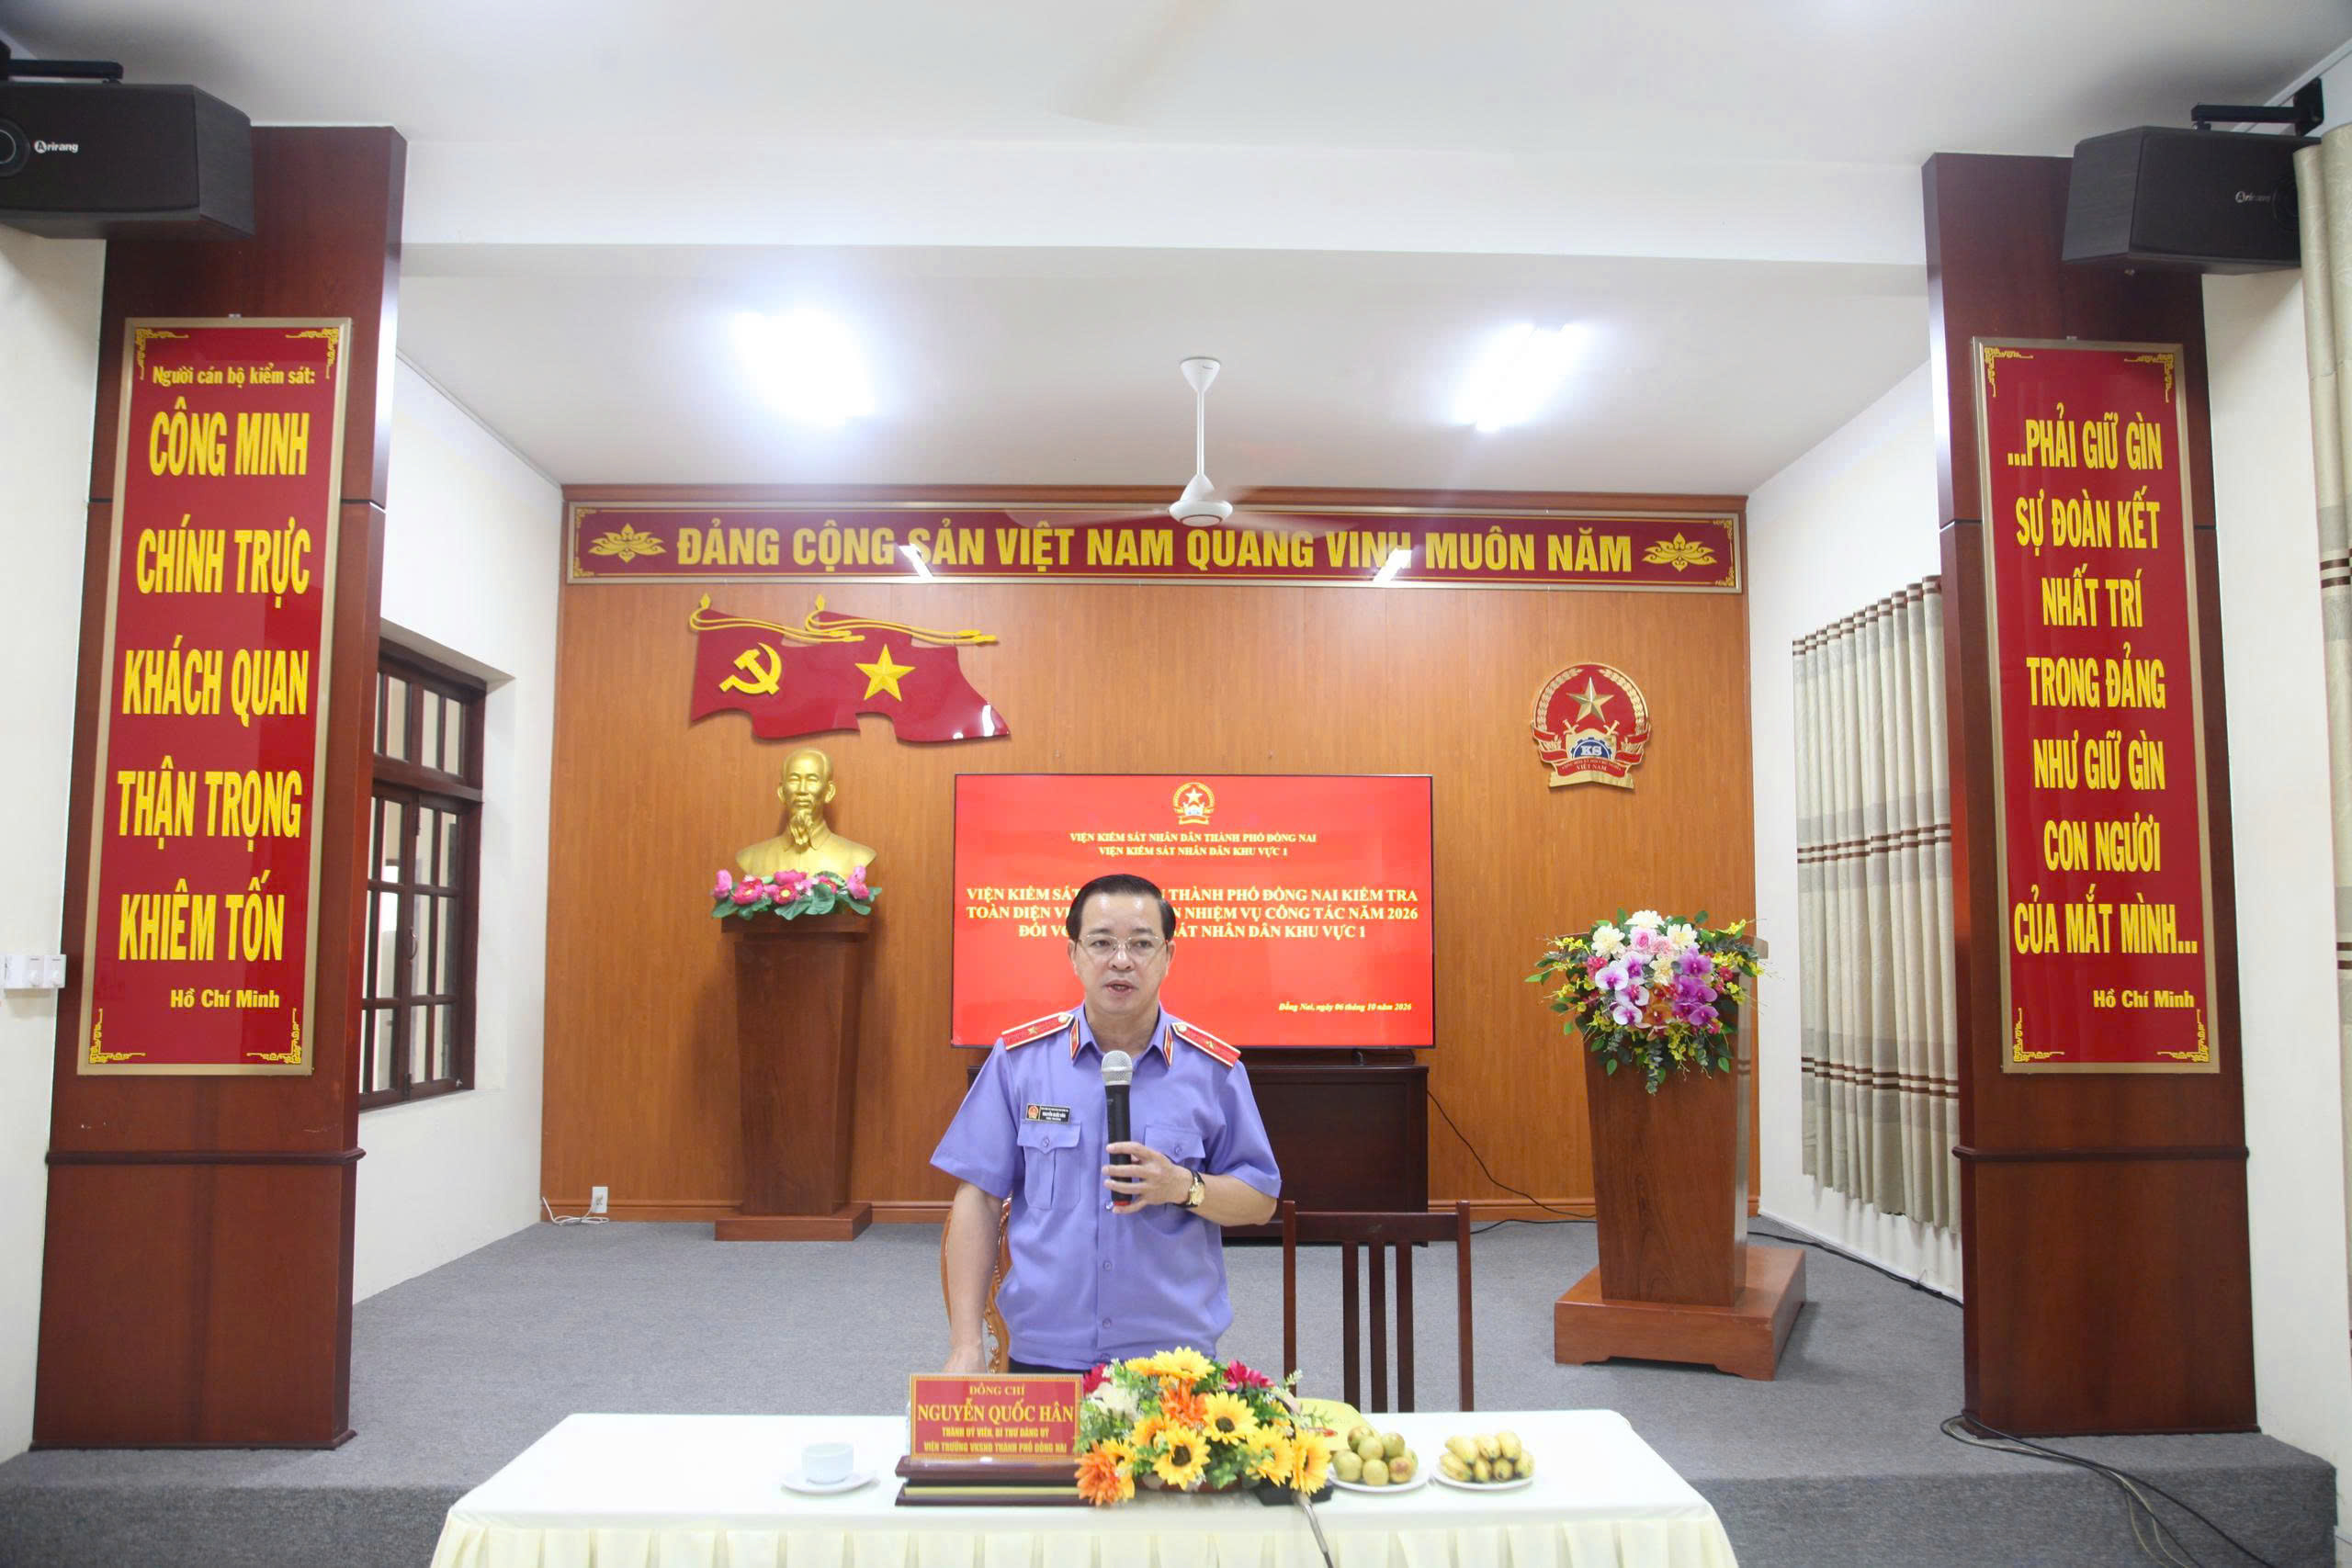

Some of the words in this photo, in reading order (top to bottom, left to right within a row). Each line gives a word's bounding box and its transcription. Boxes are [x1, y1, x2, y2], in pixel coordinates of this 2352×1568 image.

[34, 141, 79, 153] Arirang
[153, 367, 194, 386] Người
[198, 367, 222, 384] cán
[227, 367, 245, 389] bộ
[249, 363, 285, 384] kiểm
[288, 367, 315, 384] sát:
[150, 397, 228, 477] CÔNG
[235, 412, 310, 476] MINH
[2007, 402, 2077, 468] ...PHẢI
[2083, 412, 2119, 469] GIỮ
[2126, 412, 2163, 470] GÌN
[2016, 489, 2044, 557] SỰ
[2052, 489, 2112, 548] ĐOÀN
[2118, 485, 2161, 549] KẾT
[677, 518, 779, 566] ĐẢNG
[794, 520, 895, 571] CỘNG
[908, 517, 985, 566] SẢN
[996, 521, 1074, 572] VIỆT
[1088, 528, 1172, 567] NAM
[1187, 528, 1314, 571] QUANG
[1326, 531, 1412, 569] VINH
[1426, 525, 1535, 571] MUÔN
[1548, 528, 1632, 572] NĂM
[137, 514, 225, 594] CHÍNH
[234, 516, 311, 609] TRỰC
[2041, 563, 2099, 626] NHẤT
[2106, 569, 2143, 627] TRÍ
[122, 635, 223, 716] KHÁCH
[232, 649, 310, 728] QUAN
[2027, 657, 2100, 708] TRONG
[2106, 642, 2166, 709] ĐẢNG
[1580, 745, 1602, 756] KS
[2034, 730, 2079, 790] NHƯ
[2085, 729, 2122, 790] GIỮ
[2128, 729, 2166, 791] GÌN
[118, 755, 198, 851] THẬN
[205, 769, 302, 852] TRỌNG
[1070, 832, 1094, 843] VIỆN
[1097, 831, 1125, 842] KIỂM
[1127, 831, 1147, 842] SÁT
[1149, 831, 1178, 842] NHÂN
[1181, 831, 1202, 842] DÂN
[1204, 832, 1240, 842] THÀNH
[1243, 831, 1265, 842] PHỐ
[1267, 831, 1296, 842] ĐỒNG
[1299, 833, 1317, 842] NAI
[2043, 820, 2089, 872] CON
[2095, 812, 2161, 873] NGƯƠI
[1099, 845, 1124, 857] VIỆN
[1126, 845, 1154, 855] KIỂM
[1156, 845, 1176, 855] SÁT
[1178, 845, 1206, 855] NHÂN
[1209, 845, 1230, 855] DÂN
[1233, 846, 1256, 856] KHU
[1258, 846, 1281, 858] VỰC
[1283, 847, 1287, 856] 1
[967, 886, 1004, 903] VIỆN
[1008, 886, 1050, 901] KIỂM
[1169, 886, 1224, 901] THÀNH
[1227, 886, 1260, 901] PHỐ
[1262, 886, 1307, 901] ĐỒNG
[1311, 888, 1339, 901] NAI
[1342, 886, 1384, 901] KIỂM
[1386, 888, 1418, 901] TRA
[119, 878, 216, 961] KHIÊM
[225, 870, 285, 962] TỐN
[967, 904, 1010, 919] TOÀN
[1013, 905, 1051, 921] DIỆN
[1185, 905, 1237, 922] NHIỆM
[1240, 907, 1261, 922] VỤ
[1265, 904, 1310, 919] CÔNG
[1313, 904, 1346, 919] TÁC
[1349, 905, 1384, 919] NĂM
[1387, 908, 1419, 919] 2026
[2014, 885, 2060, 954] CỦA
[2065, 884, 2113, 953] MẮT
[2120, 893, 2198, 954] MÌNH...
[1018, 921, 1046, 937] ĐỐI
[1174, 921, 1198, 937] ÁT
[1202, 921, 1245, 937] NHÂN
[1249, 921, 1282, 937] DÂN
[1284, 925, 1318, 938] KHU
[1322, 924, 1356, 942] VỰC
[1359, 925, 1365, 938] 1
[171, 988, 195, 1009] Hồ
[201, 988, 231, 1008] Chí
[236, 989, 280, 1009] Minh
[1316, 1003, 1334, 1012] ngày
[1345, 1002, 1366, 1012] tháng
[1395, 1002, 1412, 1010] 2026
[2094, 989, 2117, 1009] Hồ
[2121, 990, 2149, 1008] Chí
[2154, 991, 2195, 1008] Minh
[970, 1382, 1001, 1395] ĐỒNG
[1005, 1382, 1025, 1396] CHÍ
[918, 1398, 985, 1422] NGUYỄN
[989, 1399, 1035, 1425] QUỐC
[1040, 1402, 1074, 1422] HÂN
